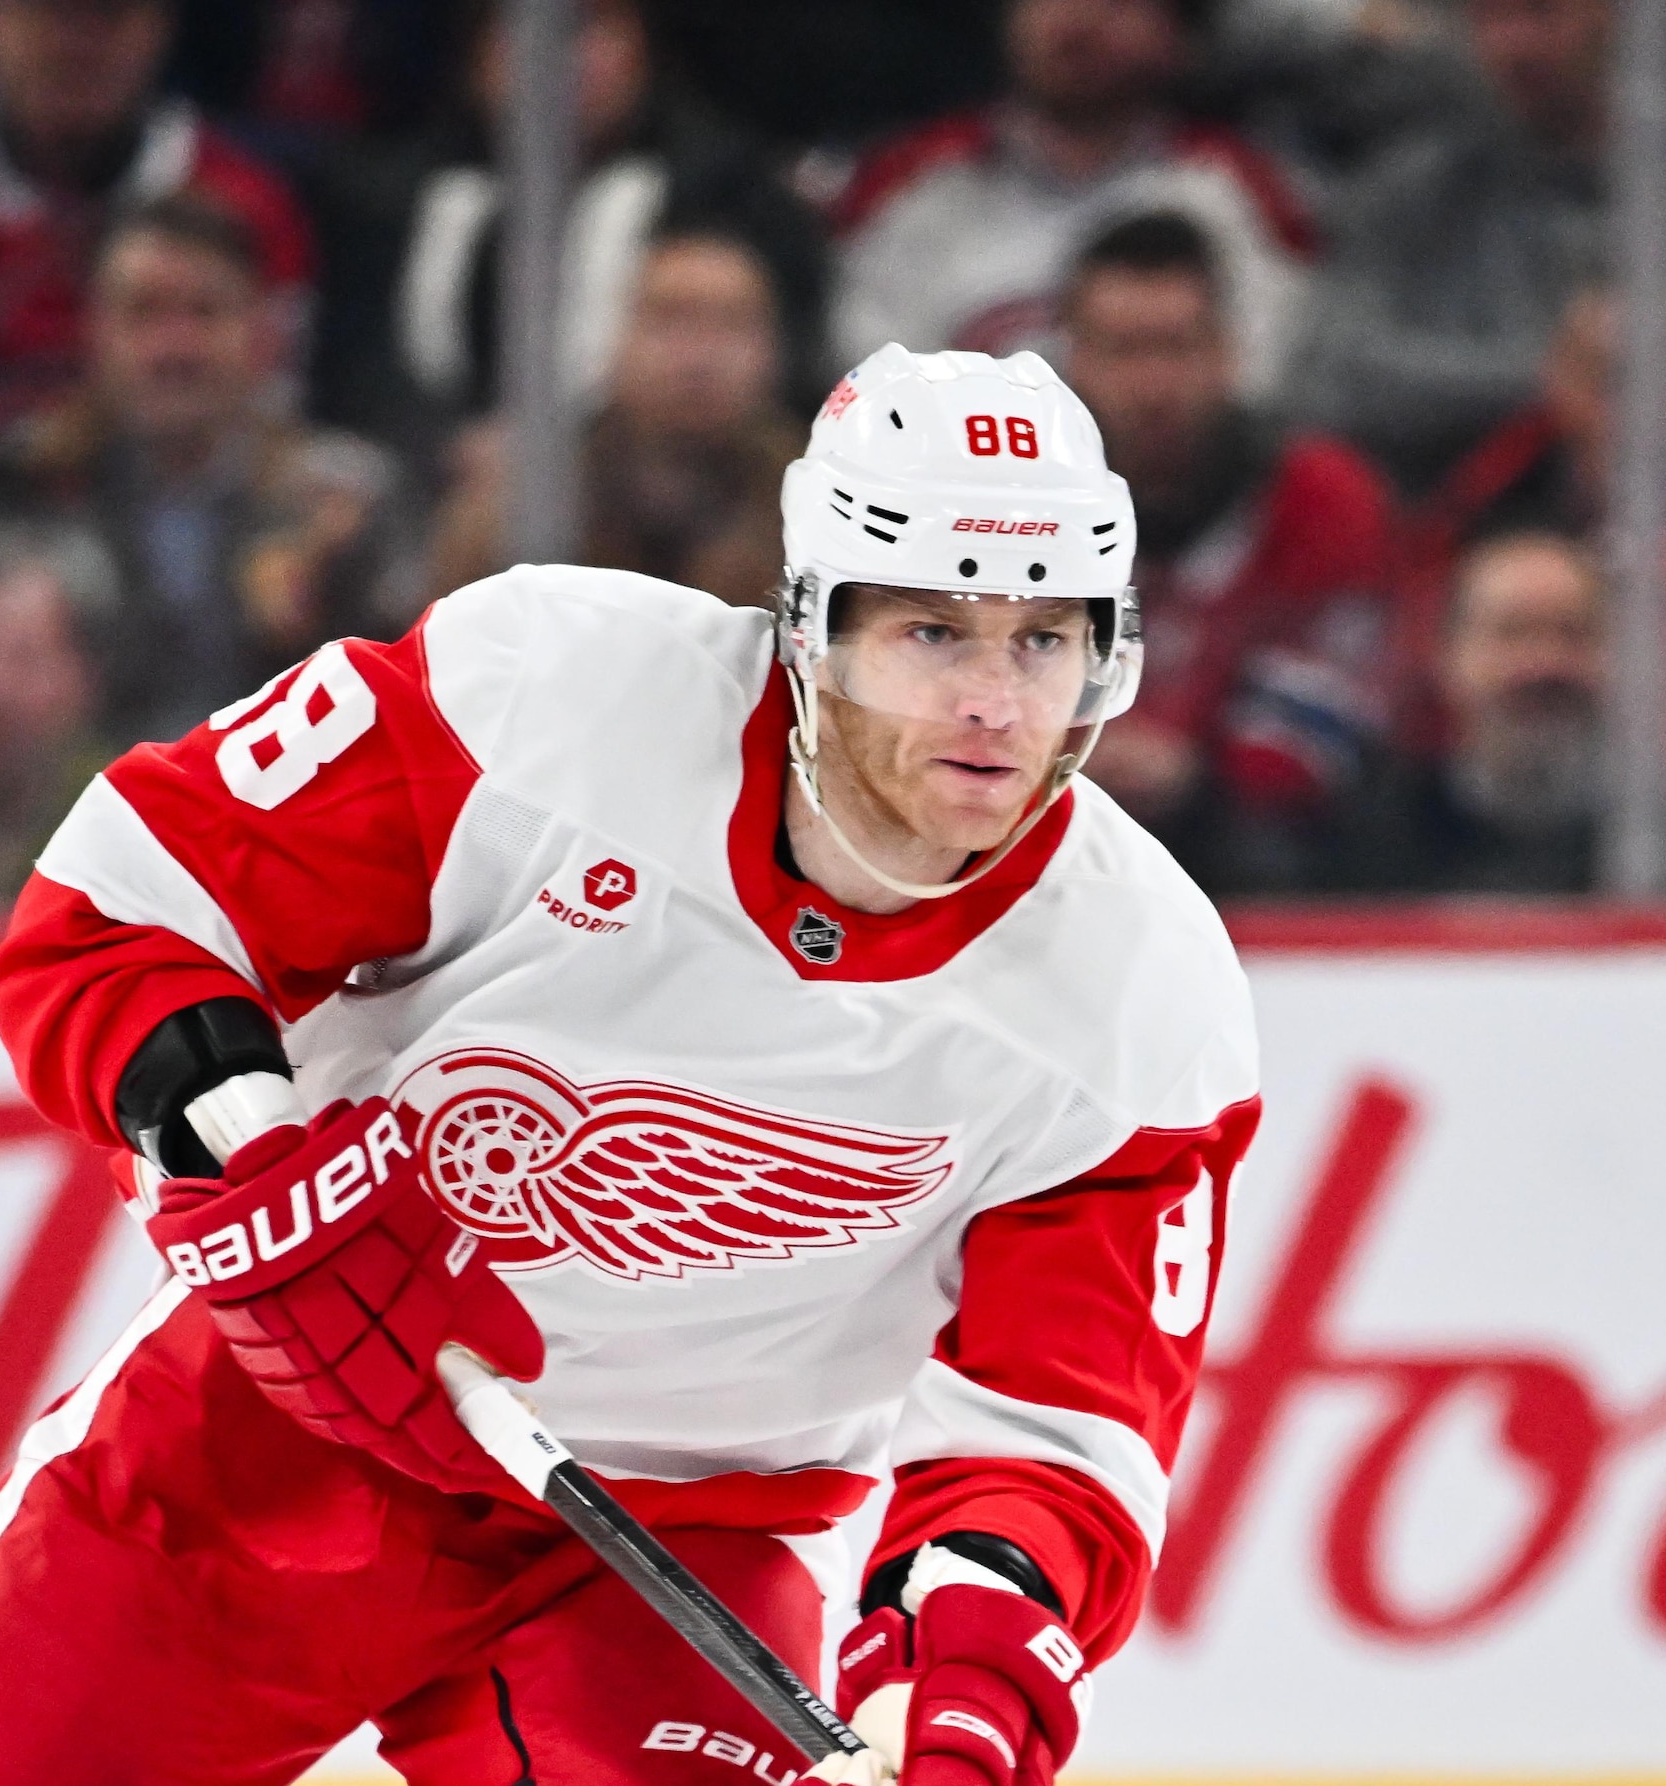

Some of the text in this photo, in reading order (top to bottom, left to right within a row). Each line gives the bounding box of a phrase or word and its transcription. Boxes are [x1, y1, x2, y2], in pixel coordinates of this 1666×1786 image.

[964, 414, 1040, 460] 88
[951, 517, 1061, 537] BAUER
[209, 636, 378, 812] 8
[536, 887, 632, 935] PRIORITY
[165, 1110, 413, 1288] BAUER
[1151, 1160, 1244, 1338] 8
